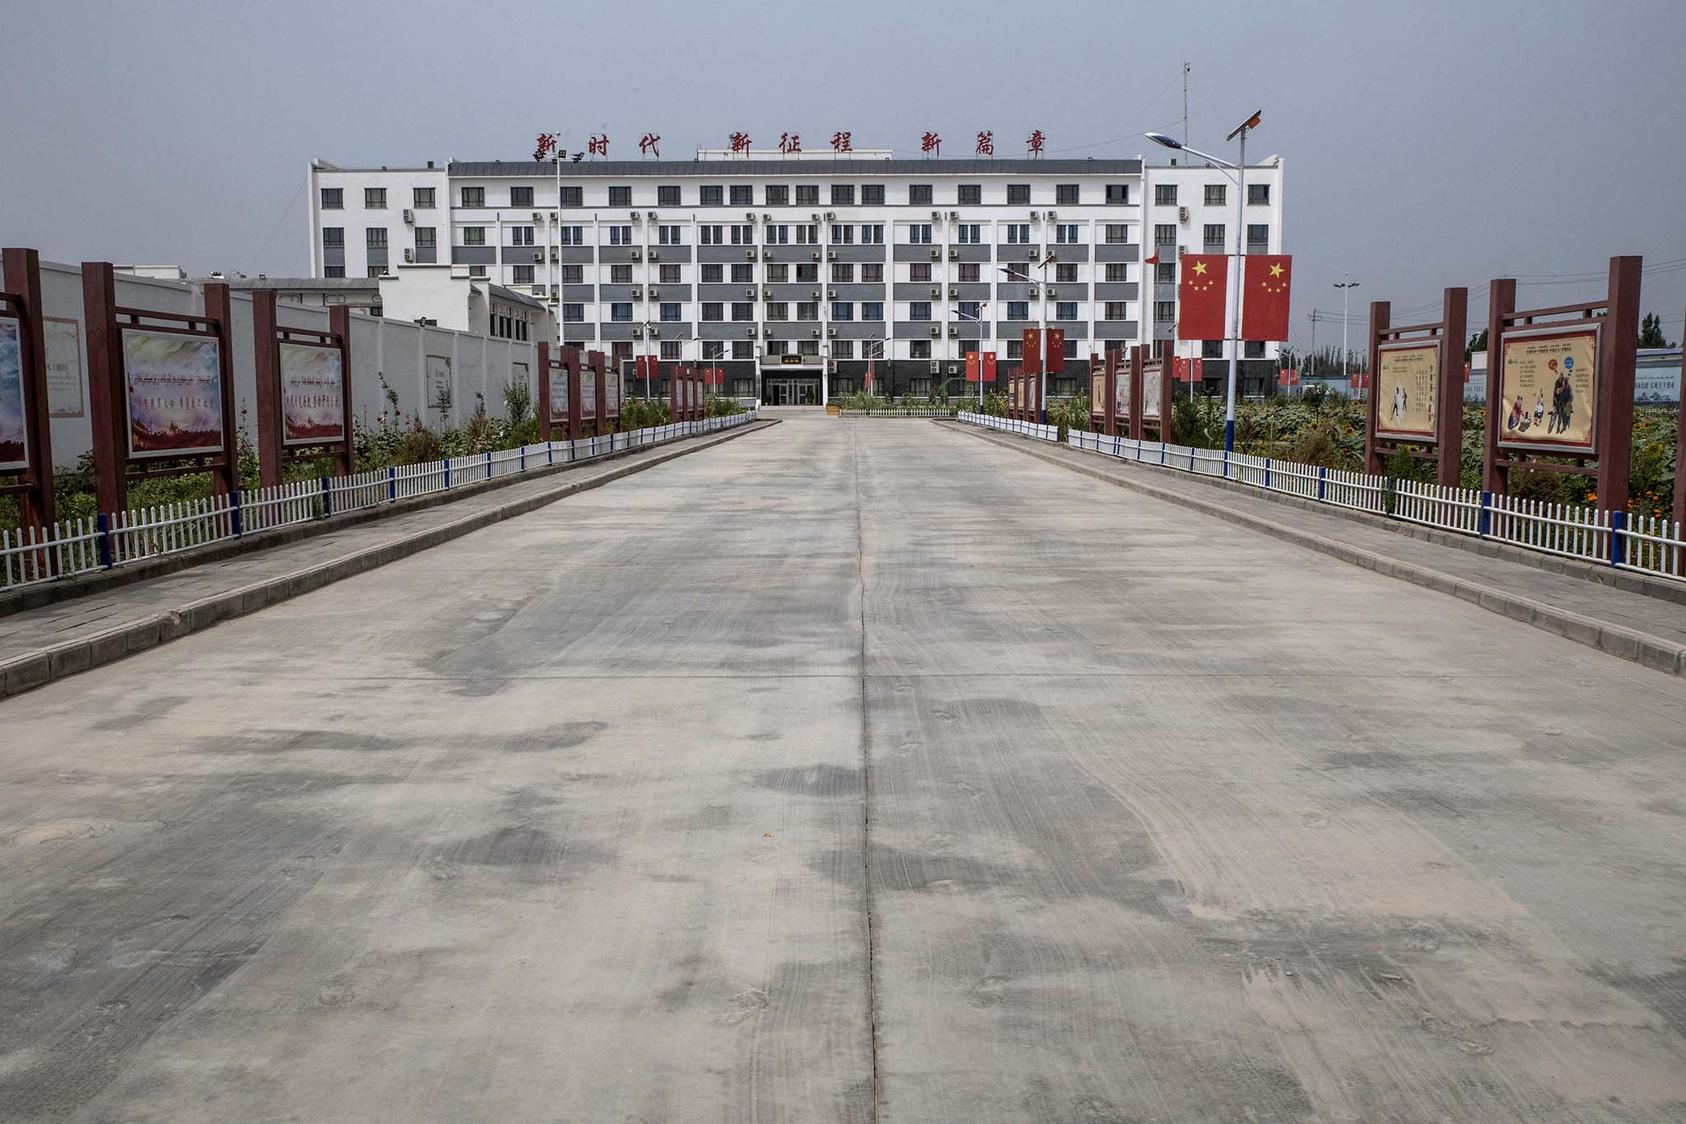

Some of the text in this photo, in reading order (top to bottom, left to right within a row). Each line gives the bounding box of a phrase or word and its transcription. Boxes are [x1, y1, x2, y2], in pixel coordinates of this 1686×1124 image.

[537, 130, 1047, 157] 新时代 新征程 新篇章
